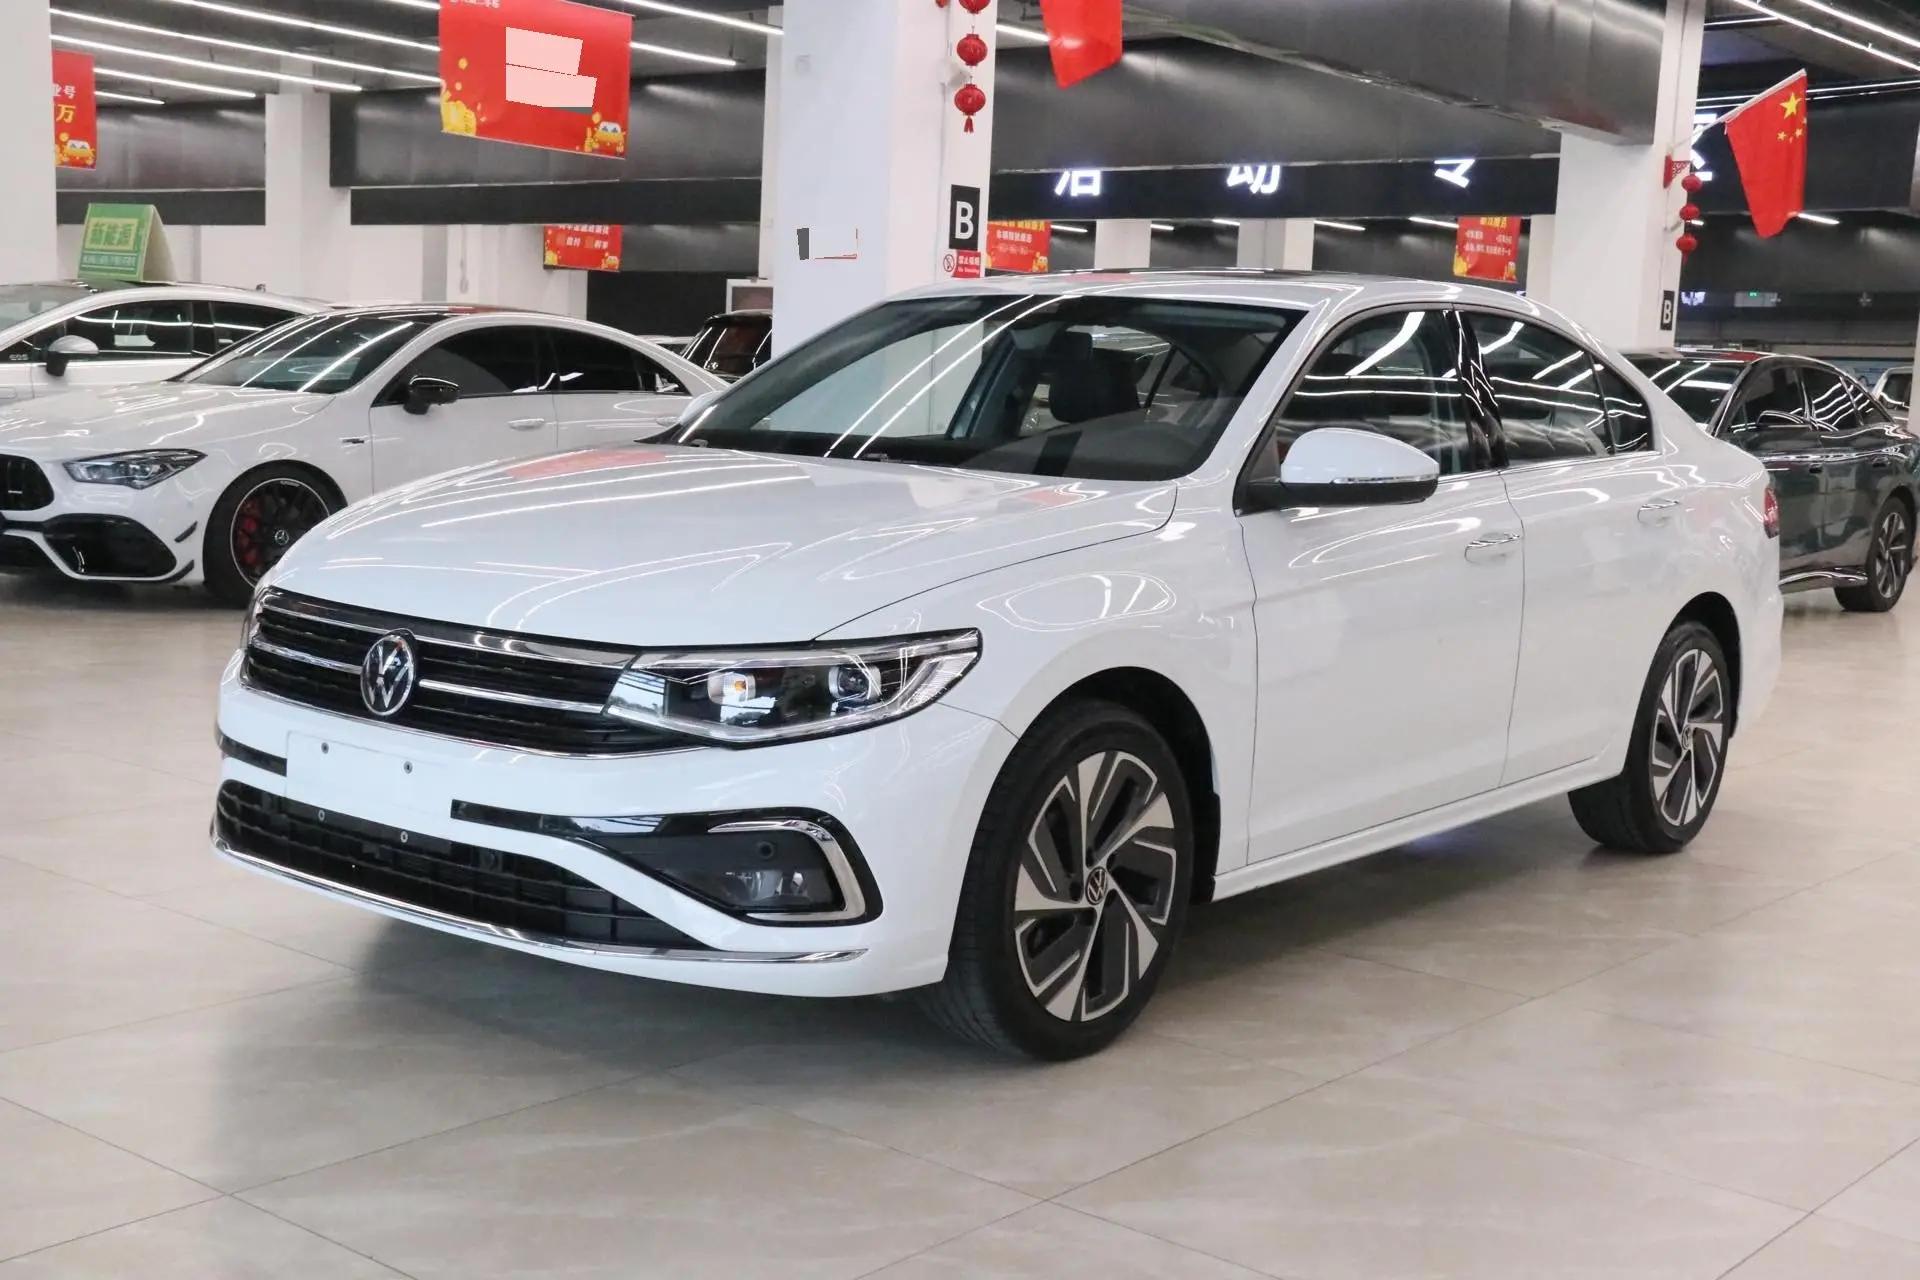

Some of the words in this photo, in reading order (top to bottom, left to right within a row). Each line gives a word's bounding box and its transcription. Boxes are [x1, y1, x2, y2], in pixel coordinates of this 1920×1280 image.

[56, 104, 76, 123] 万
[955, 200, 974, 240] B
[1662, 299, 1672, 324] B
